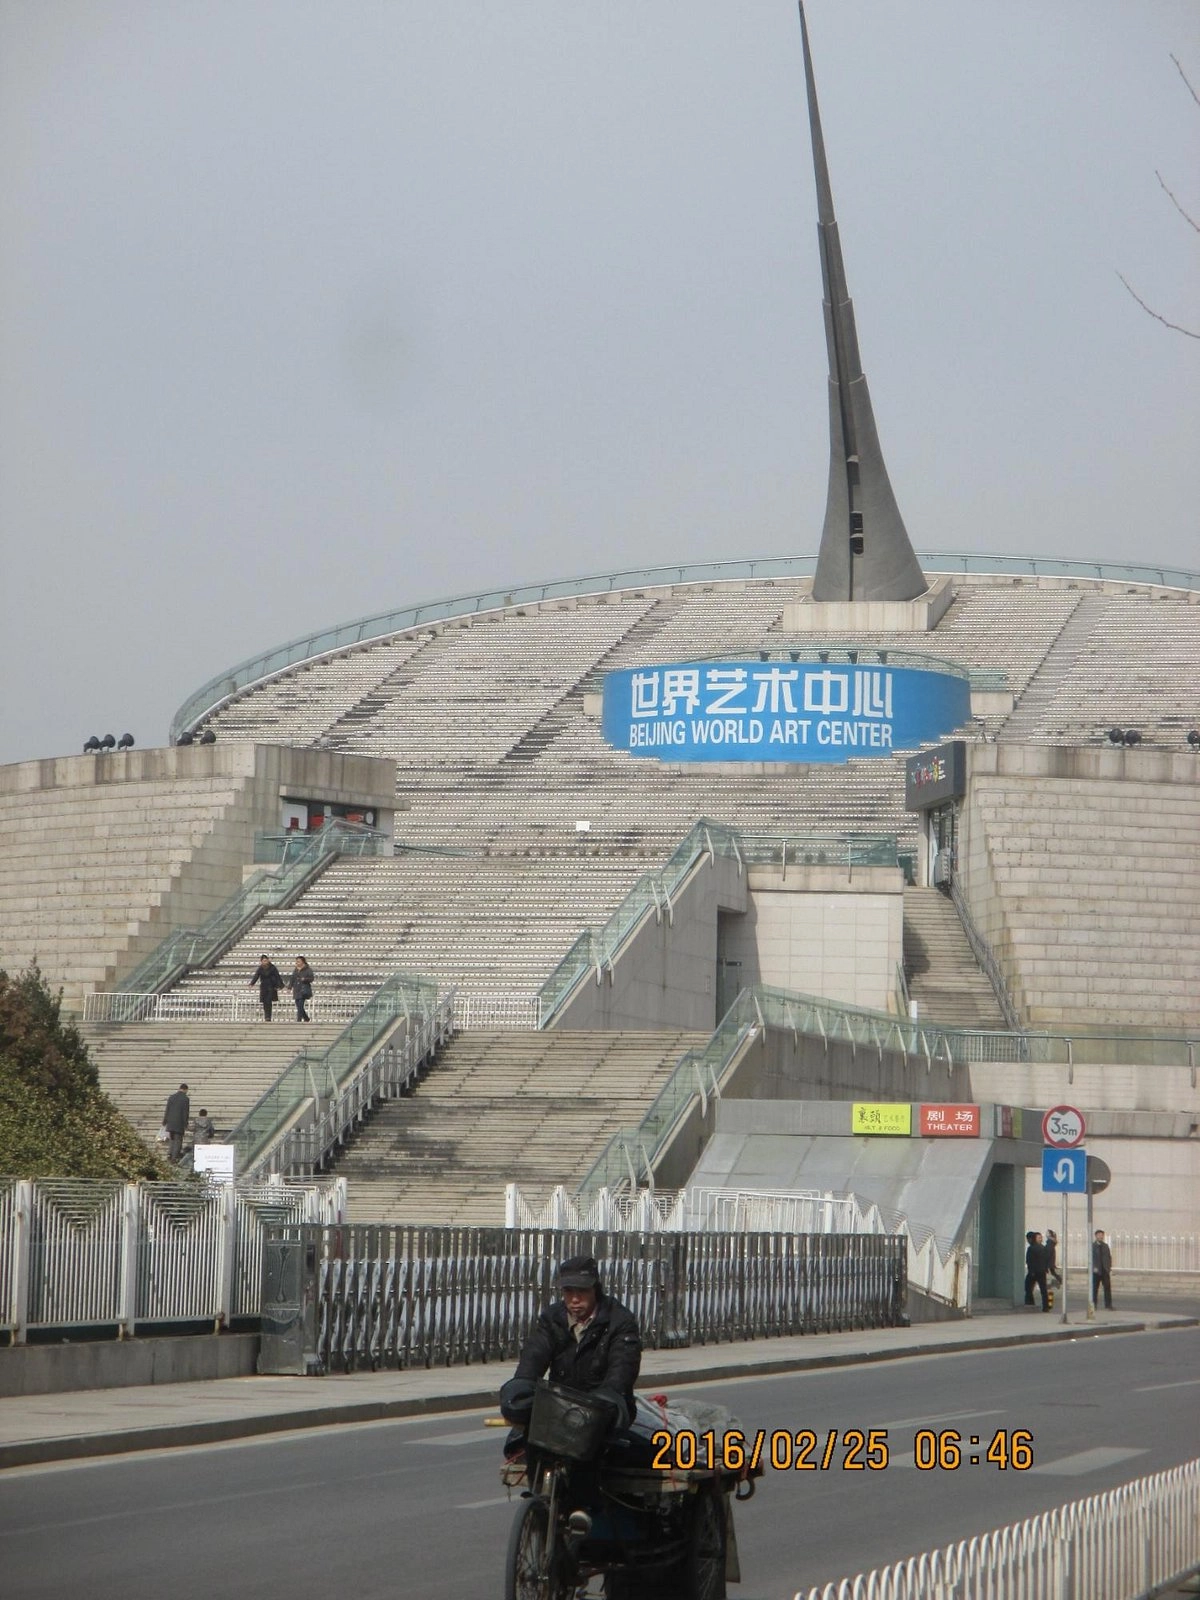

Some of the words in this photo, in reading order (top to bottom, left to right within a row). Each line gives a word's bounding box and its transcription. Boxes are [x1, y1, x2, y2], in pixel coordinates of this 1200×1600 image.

[630, 669, 893, 719] 世界艺术中心
[629, 720, 686, 748] BEIJING
[691, 719, 763, 745] WORLD
[769, 719, 812, 745] ART
[816, 720, 893, 748] CENTER
[926, 1110, 973, 1122] 剧场
[927, 1123, 973, 1131] THEATER
[1050, 1117, 1078, 1136] 3.5m
